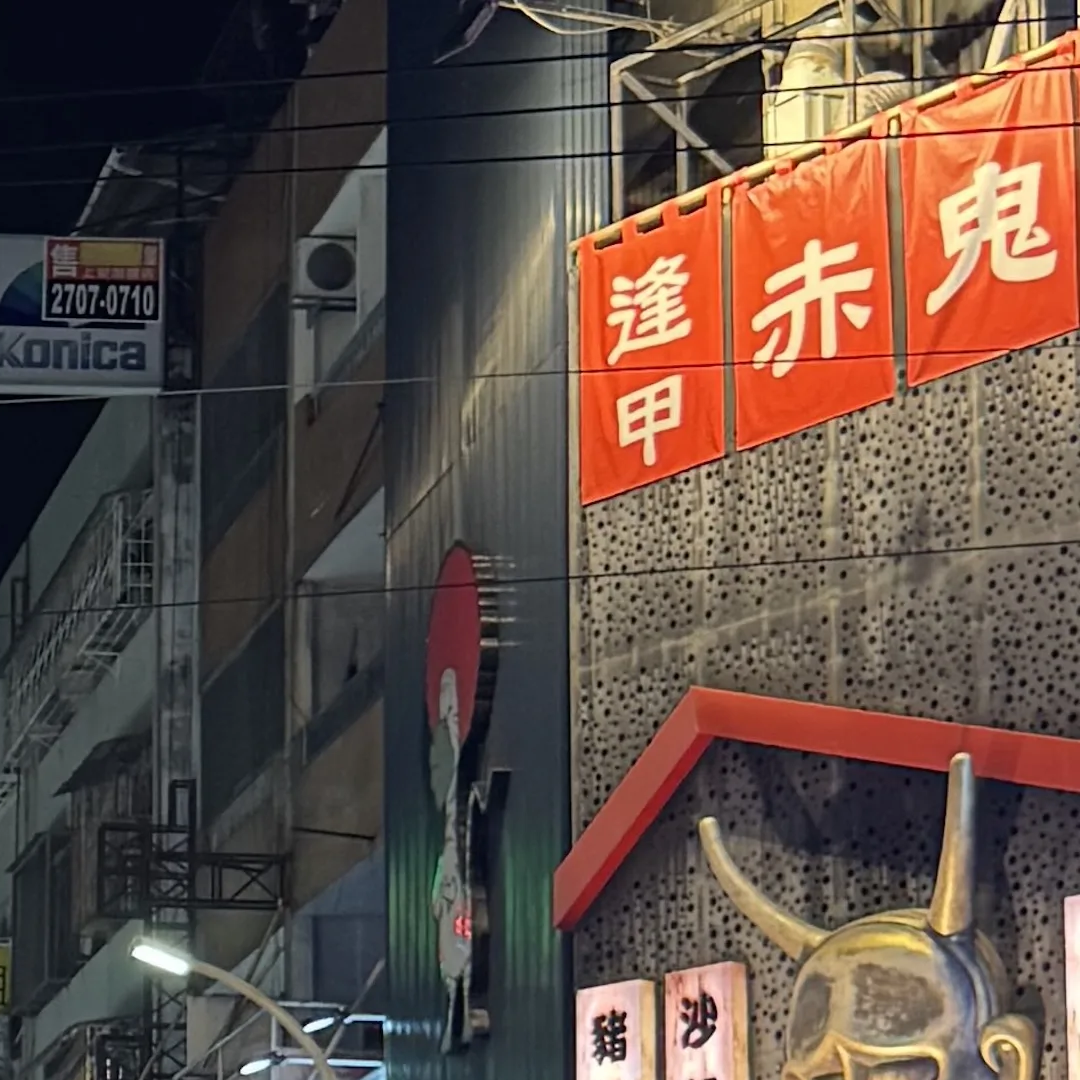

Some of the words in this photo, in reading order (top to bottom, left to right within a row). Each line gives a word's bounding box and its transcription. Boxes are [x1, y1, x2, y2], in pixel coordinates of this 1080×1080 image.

[752, 239, 875, 378] 赤
[926, 162, 1058, 316] 鬼
[607, 253, 693, 467] 逢甲
